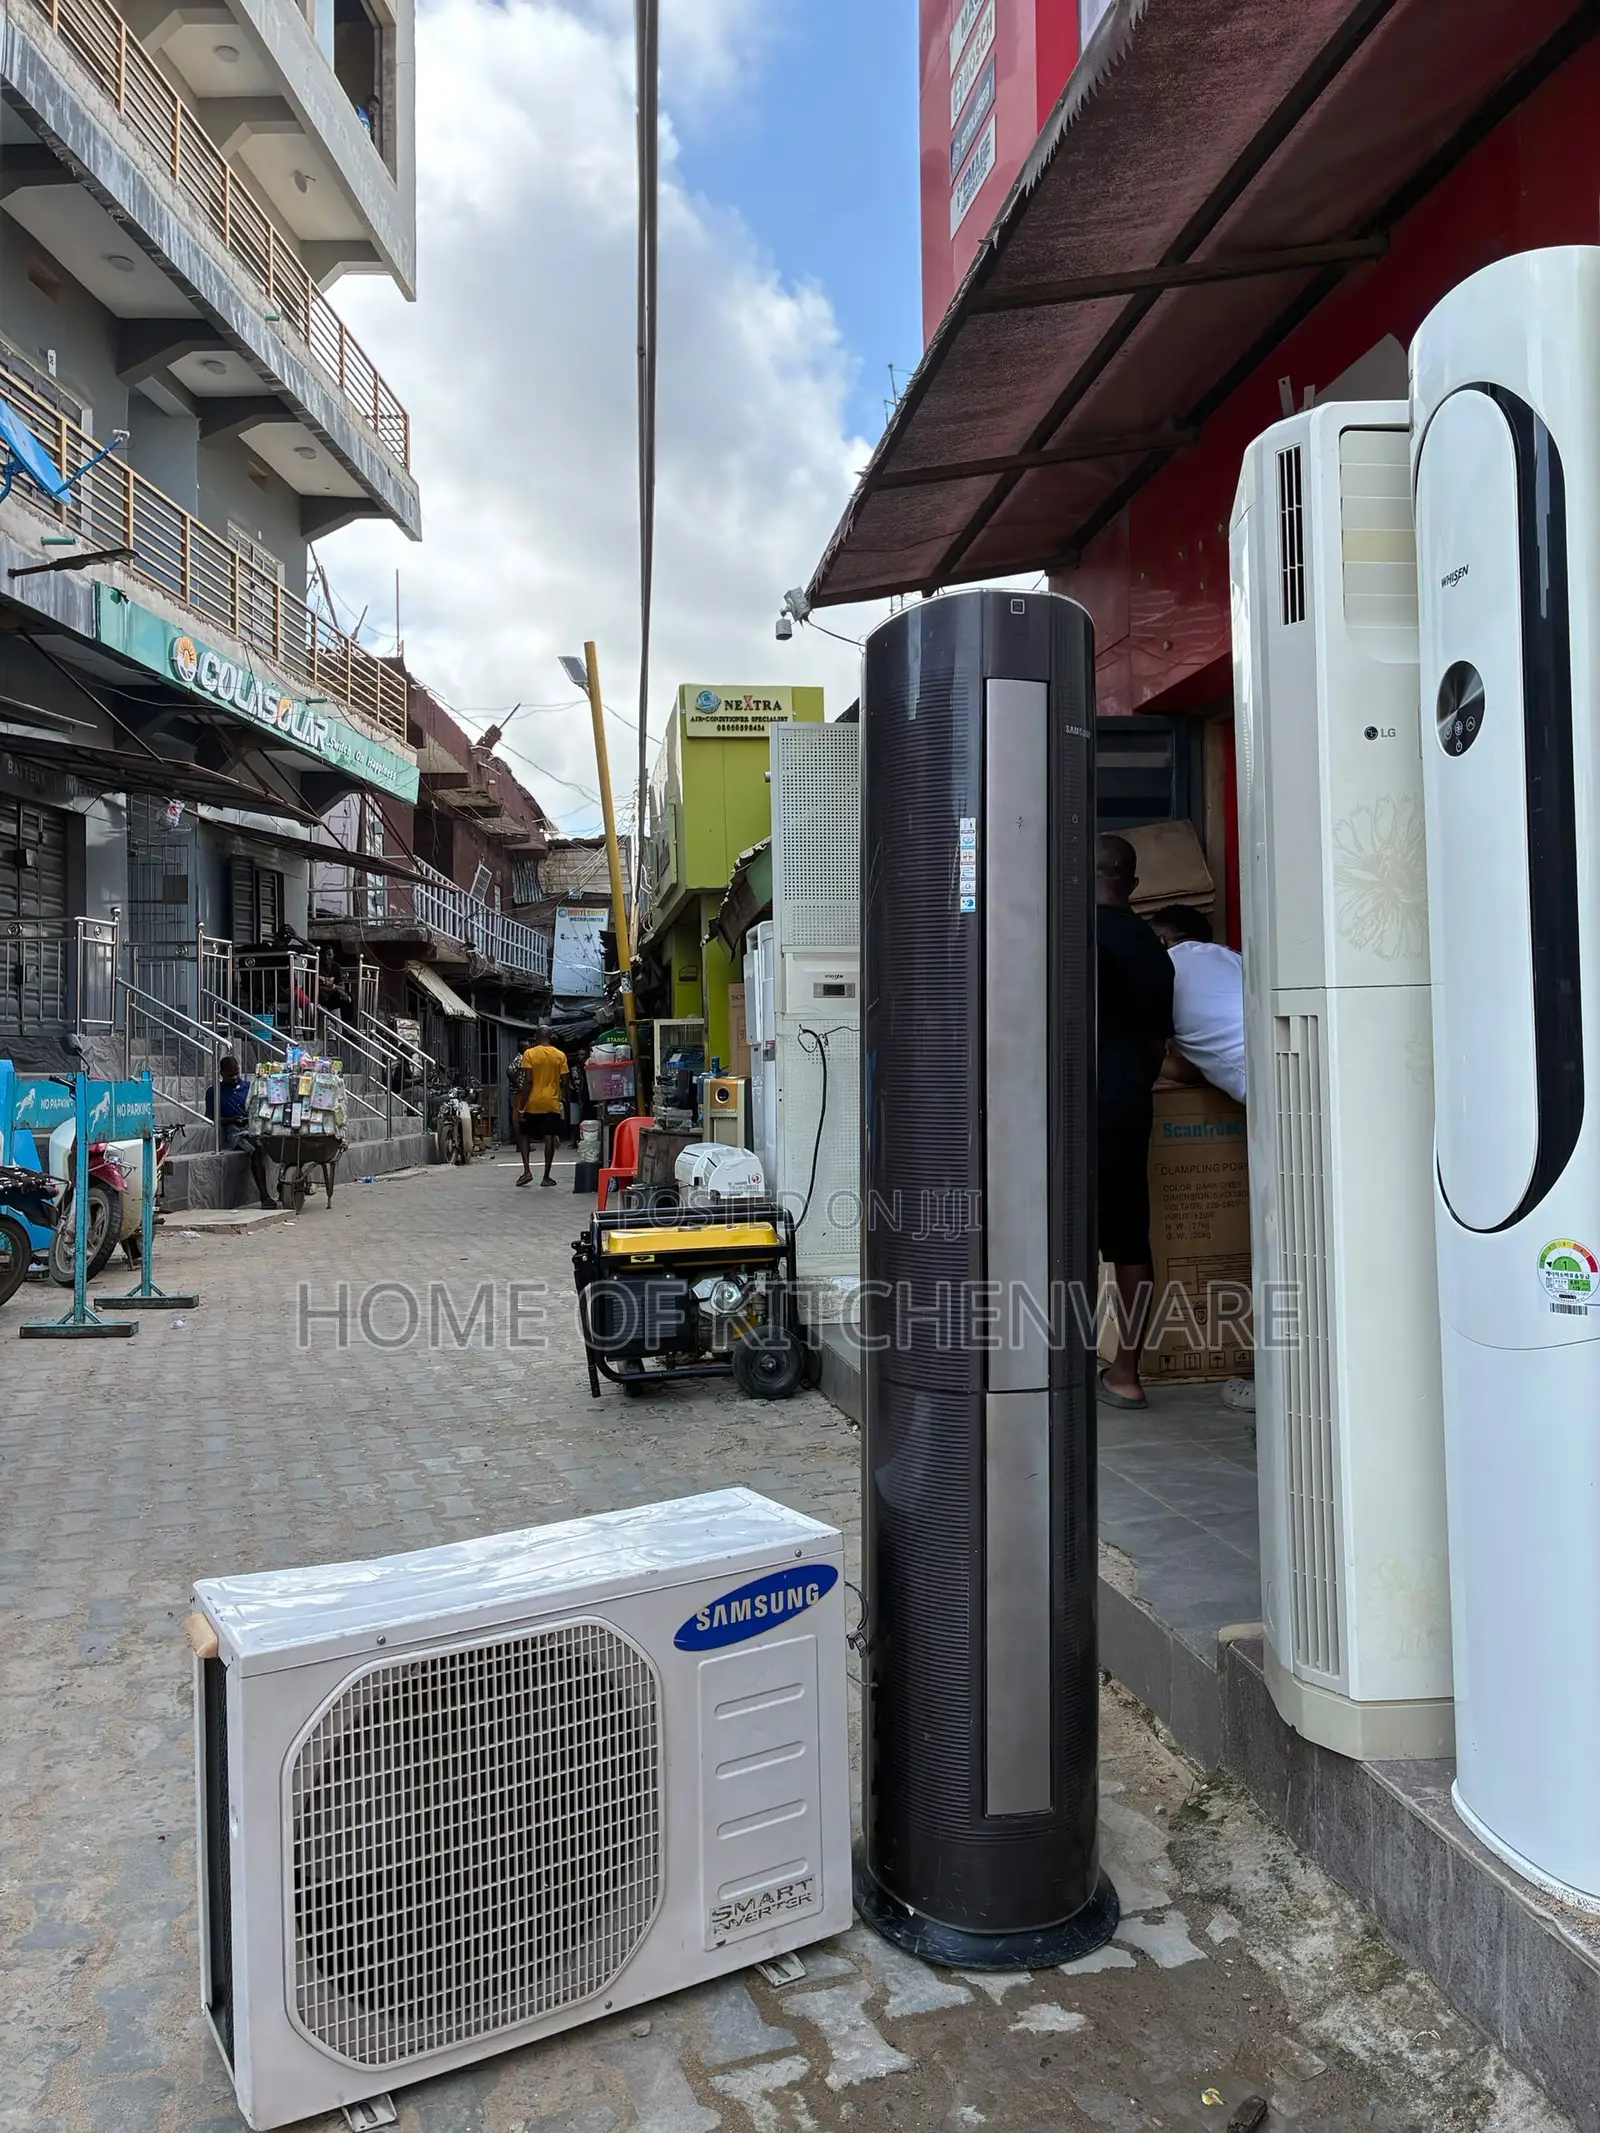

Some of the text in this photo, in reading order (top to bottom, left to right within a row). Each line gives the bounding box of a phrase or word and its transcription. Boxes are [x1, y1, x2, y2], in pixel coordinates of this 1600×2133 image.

[1441, 564, 1469, 588] WHISEN
[197, 651, 329, 751] COLASOLAR
[725, 695, 782, 711] NEXTRA
[1381, 728, 1396, 738] LG
[8, 759, 46, 787] BATTERY
[367, 756, 397, 780] Happiness
[40, 1099, 49, 1110] NO
[117, 1103, 151, 1117] NO PARKING
[1161, 1163, 1220, 1176] CLAMPLING
[696, 1583, 820, 1631] SAMSUNG
[712, 1878, 813, 1923] SMART
